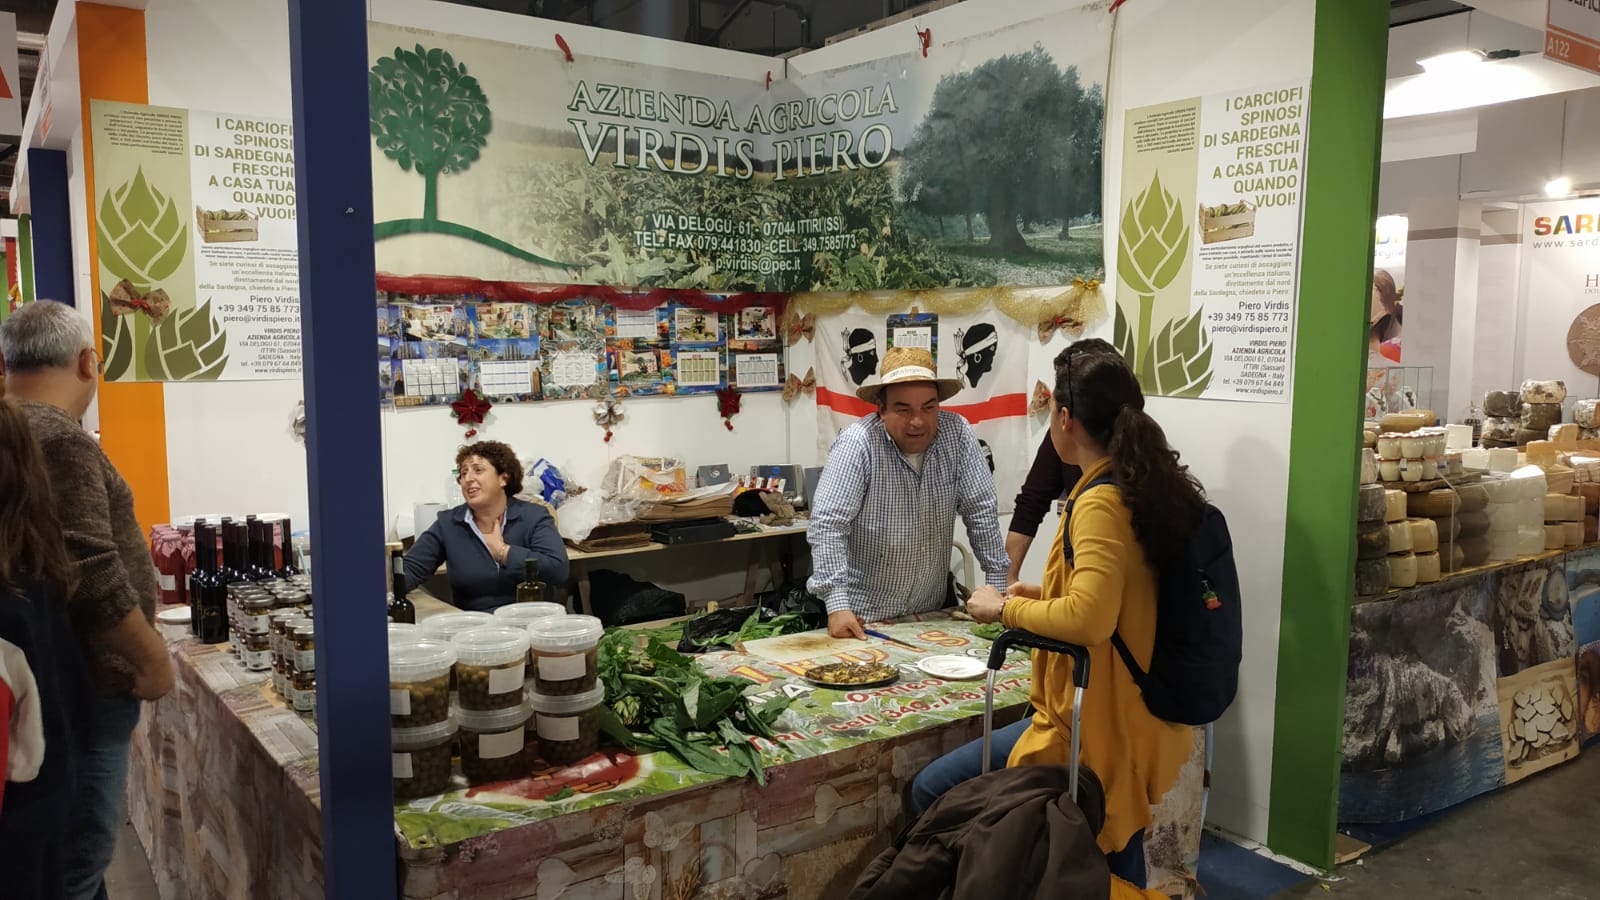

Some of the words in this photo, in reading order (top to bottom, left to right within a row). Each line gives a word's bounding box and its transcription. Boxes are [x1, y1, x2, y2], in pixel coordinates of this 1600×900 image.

[1547, 37, 1570, 58] A122
[567, 80, 739, 131] AZIENDA
[744, 82, 898, 135] AGRICOLA
[1226, 99, 1230, 111] I
[1234, 87, 1303, 110] CARCIOFI
[1241, 105, 1302, 126] SPINOSI
[216, 117, 220, 129] I
[224, 118, 293, 136] CARCIOFI
[1204, 134, 1217, 147] DI
[1221, 122, 1301, 146] SARDEGNA
[234, 134, 294, 150] SPINOSI
[568, 118, 754, 181] VIRDIS
[773, 123, 892, 182] PIERO
[1237, 140, 1300, 160] FRESCHI
[194, 145, 209, 157] DI
[214, 146, 294, 164] SARDEGNA
[232, 163, 294, 178] FRESCHI
[1213, 166, 1222, 179] A
[1226, 161, 1264, 178] CASA
[1269, 157, 1298, 173] TUA
[209, 176, 218, 187] A
[223, 177, 261, 190] CASA
[266, 179, 295, 192] TUA
[1234, 175, 1297, 194] QUANDO
[232, 191, 295, 206] QUANDO
[1255, 192, 1296, 208] VUOI!
[257, 207, 296, 220] VUOI!
[652, 214, 675, 229] VIA
[679, 215, 735, 235] DELOGU,
[739, 221, 751, 235] 61
[763, 221, 795, 236] 07044
[634, 231, 664, 247] TEL.
[669, 233, 694, 248] FAX
[803, 234, 856, 252] 349.7585773
[716, 256, 800, 275] p.virdis@pec.it
[218, 304, 235, 312] +39
[237, 304, 254, 312] 349
[257, 305, 267, 313] 75
[270, 305, 281, 313] 85
[283, 305, 299, 313] 773
[250, 295, 273, 303] Piero
[1239, 301, 1261, 310] Piero
[1264, 301, 1290, 310] Virdis
[1208, 312, 1223, 321] +39
[1225, 312, 1242, 321] 349
[1245, 312, 1255, 321] 75
[1257, 312, 1269, 321] 85
[1272, 313, 1289, 321] 773
[1212, 324, 1288, 334] piero@virdispiero.it
